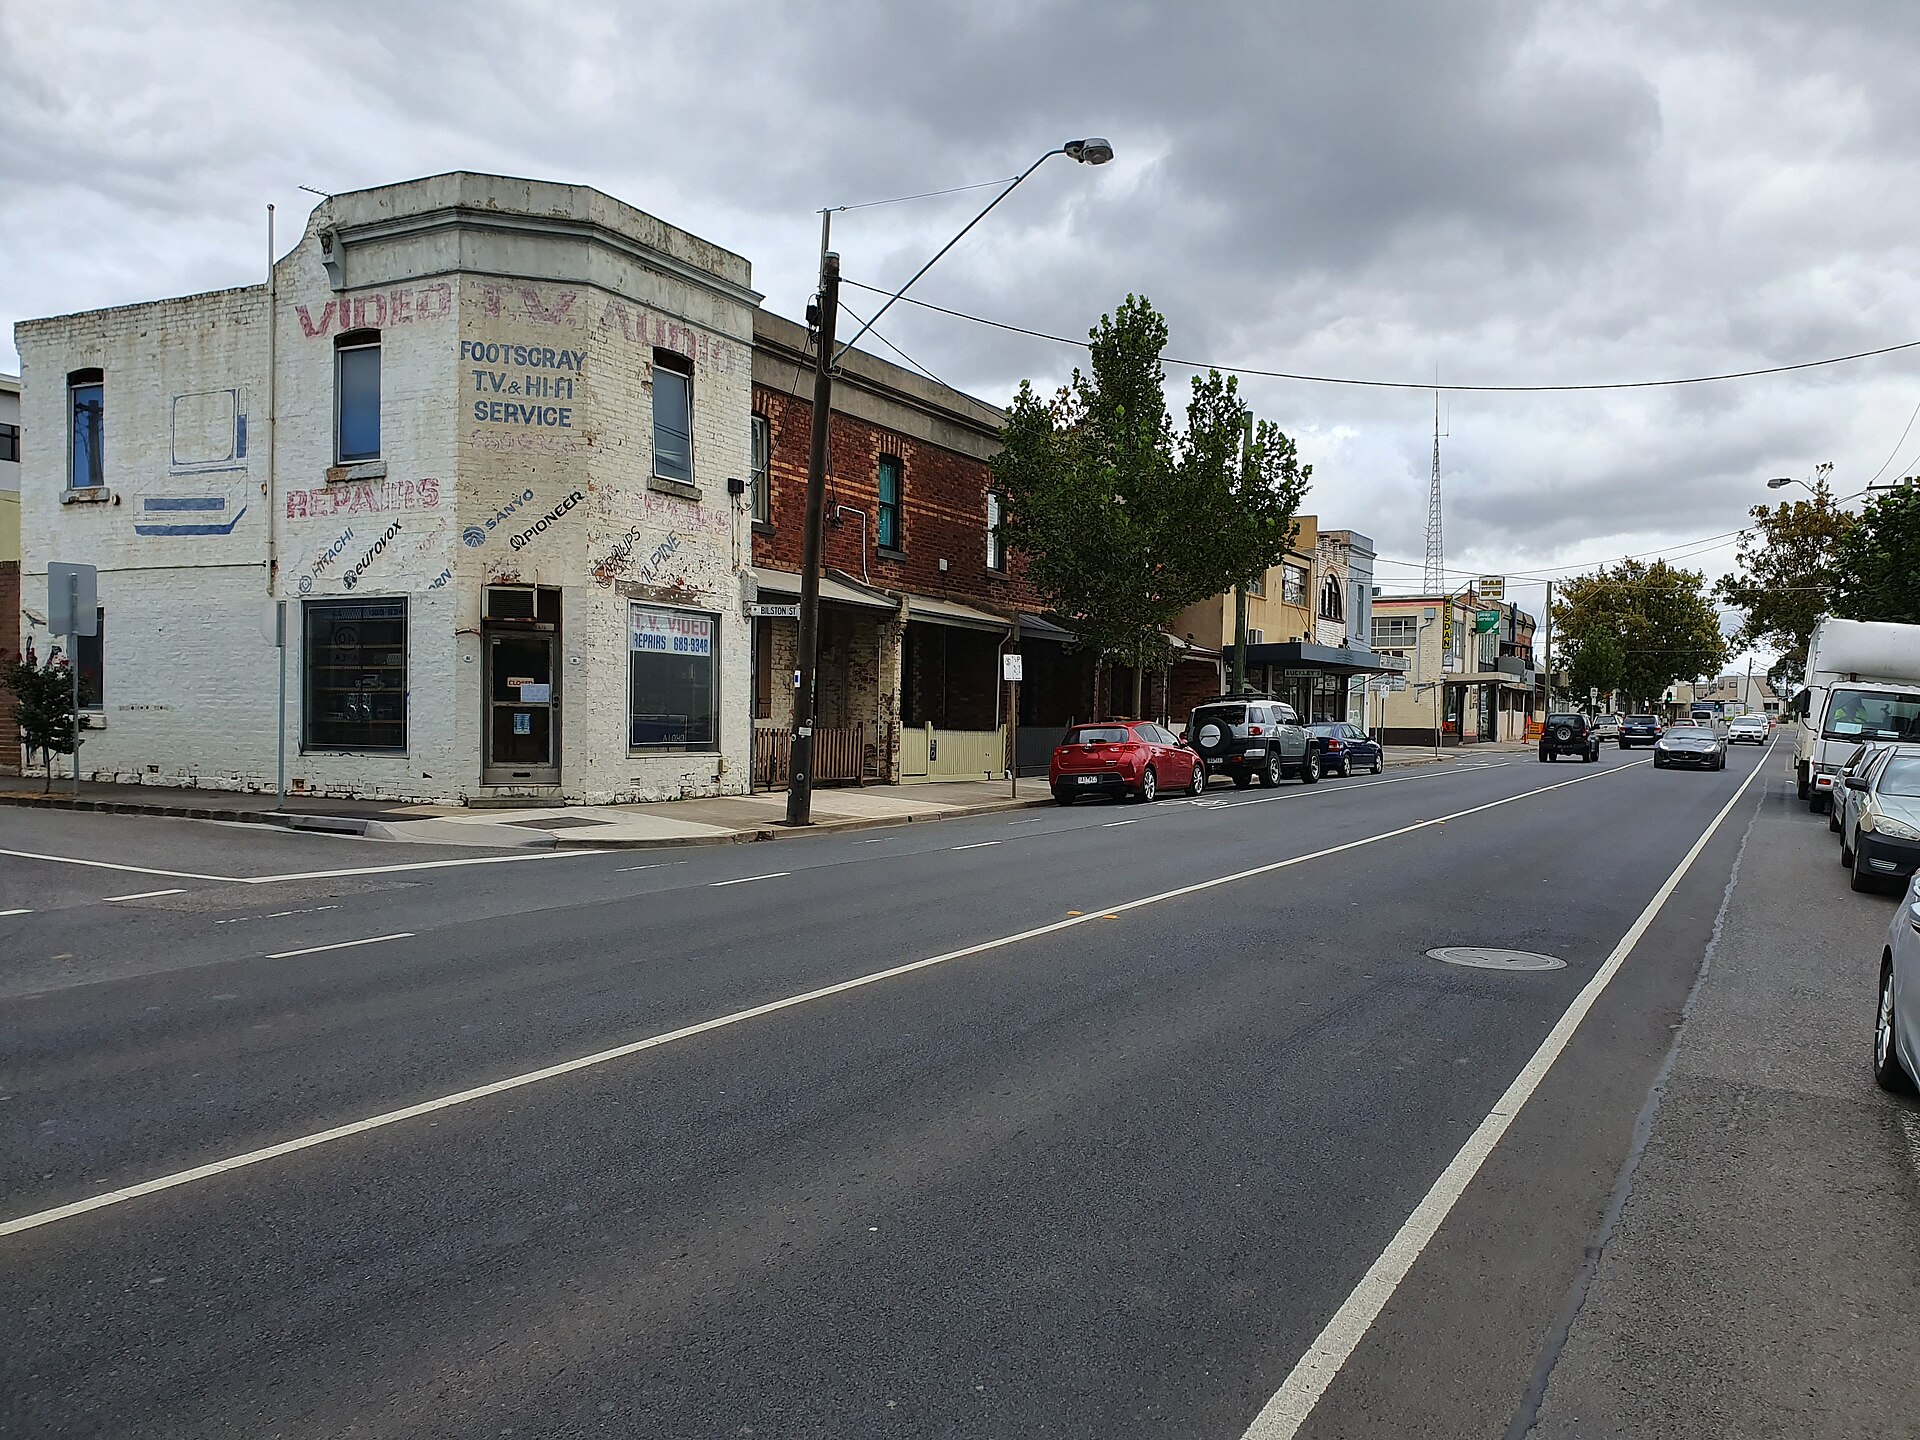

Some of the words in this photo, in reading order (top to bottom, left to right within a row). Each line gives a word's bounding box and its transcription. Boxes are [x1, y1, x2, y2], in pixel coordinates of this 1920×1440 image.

[294, 282, 452, 338] VIDEO
[460, 340, 588, 371] FOOTSCRAY
[508, 381, 522, 395] &
[474, 400, 573, 428] SERVICE
[286, 478, 440, 519] REPAIRS
[485, 489, 534, 530] SANYO
[522, 491, 586, 542] PIONEER
[312, 527, 355, 578] HITACHI
[355, 518, 403, 575] eurovox
[668, 618, 709, 637] VIDEO
[760, 606, 787, 615] BILSTON
[789, 607, 797, 615] ST
[1443, 596, 1453, 648] WESDAN
